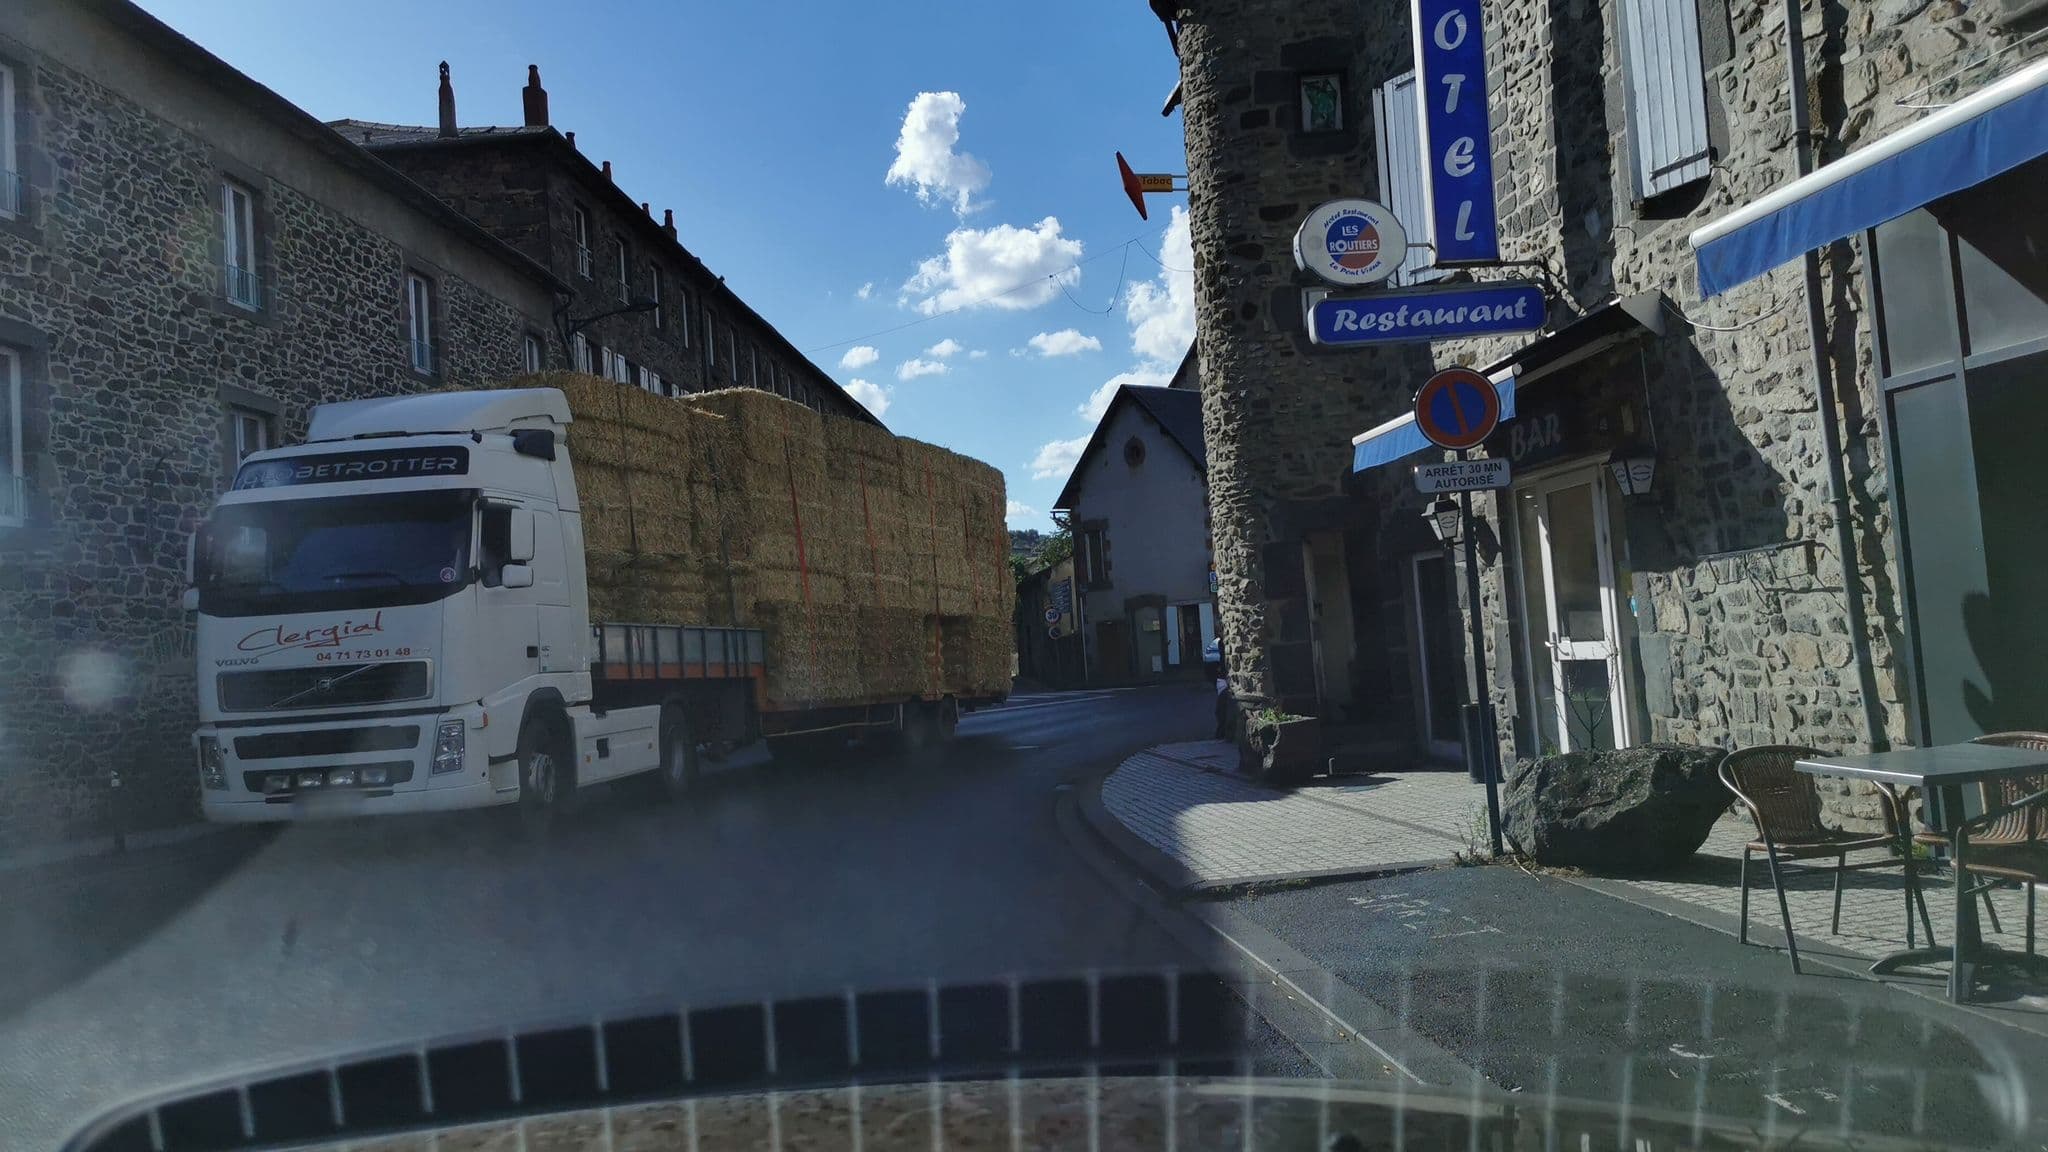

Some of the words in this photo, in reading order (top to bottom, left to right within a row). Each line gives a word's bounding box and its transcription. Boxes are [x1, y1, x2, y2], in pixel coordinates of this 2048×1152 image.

[1142, 176, 1172, 185] Tabac
[1342, 225, 1359, 236] LES
[1330, 240, 1378, 252] ROUTIERS
[1333, 296, 1528, 332] Restaurant
[1510, 413, 1562, 461] BAR
[1425, 464, 1464, 478] ARRÊT
[1469, 465, 1482, 474] 30
[1484, 462, 1502, 473] MN
[1434, 474, 1495, 489] AUTORISÉ
[237, 610, 384, 650] Clergial
[215, 656, 259, 667] VOLVO
[316, 652, 331, 661] 04
[336, 651, 351, 660] 71
[356, 650, 371, 659] 73
[376, 648, 389, 657] 01
